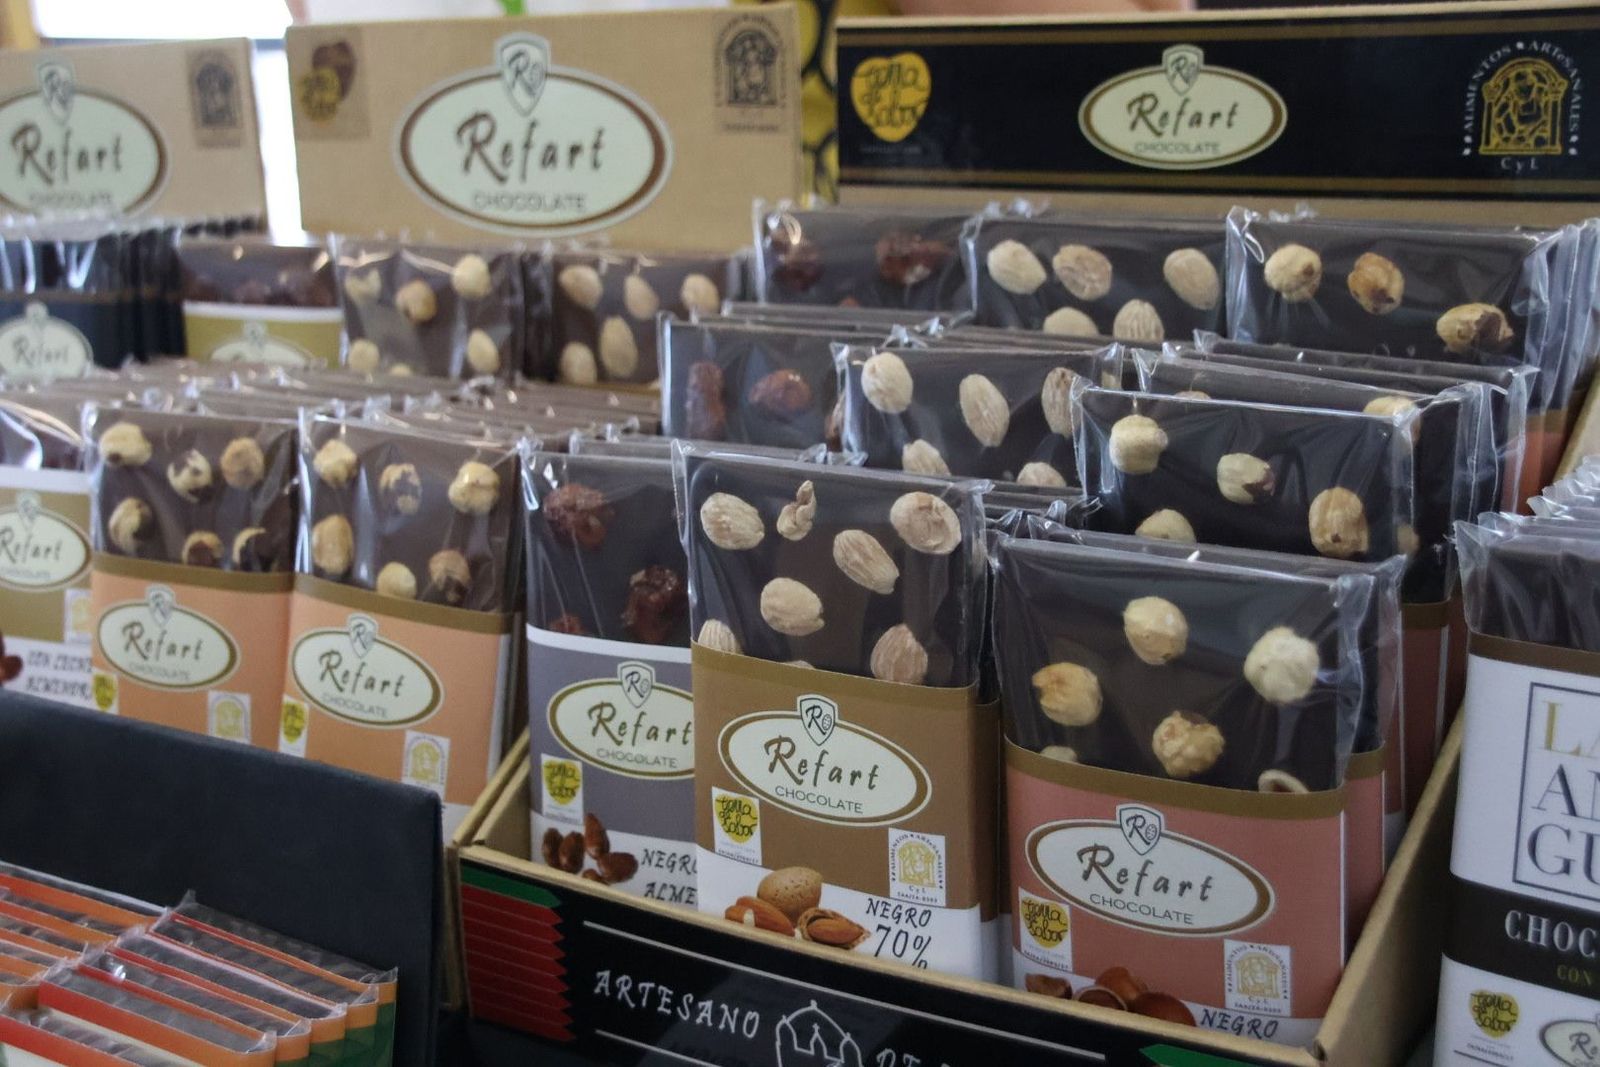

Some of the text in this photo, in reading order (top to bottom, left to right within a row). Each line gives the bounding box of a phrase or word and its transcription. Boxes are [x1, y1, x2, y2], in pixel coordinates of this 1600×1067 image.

[1127, 92, 1239, 138] Refart
[10, 123, 122, 185] Refart
[456, 112, 604, 183] Refart
[1134, 142, 1221, 155] CHOCOLATE
[473, 191, 587, 214] CHOCOLATE
[121, 620, 204, 661] Refart
[318, 648, 405, 697] Refart
[321, 691, 389, 718] CHOCOLATE
[587, 700, 692, 747] Refart
[595, 747, 678, 769] CHOCOLATE
[763, 735, 879, 790] Refart
[774, 785, 864, 815] CHOCOLATE
[1076, 843, 1213, 902] Refart
[866, 898, 933, 929] NEGRO
[1089, 893, 1194, 925] CHOCOLATE
[874, 923, 932, 970] 70%
[1504, 909, 1597, 959] CHOC
[594, 970, 761, 1039] ARTESANO
[1200, 1008, 1279, 1040] NEGRO
